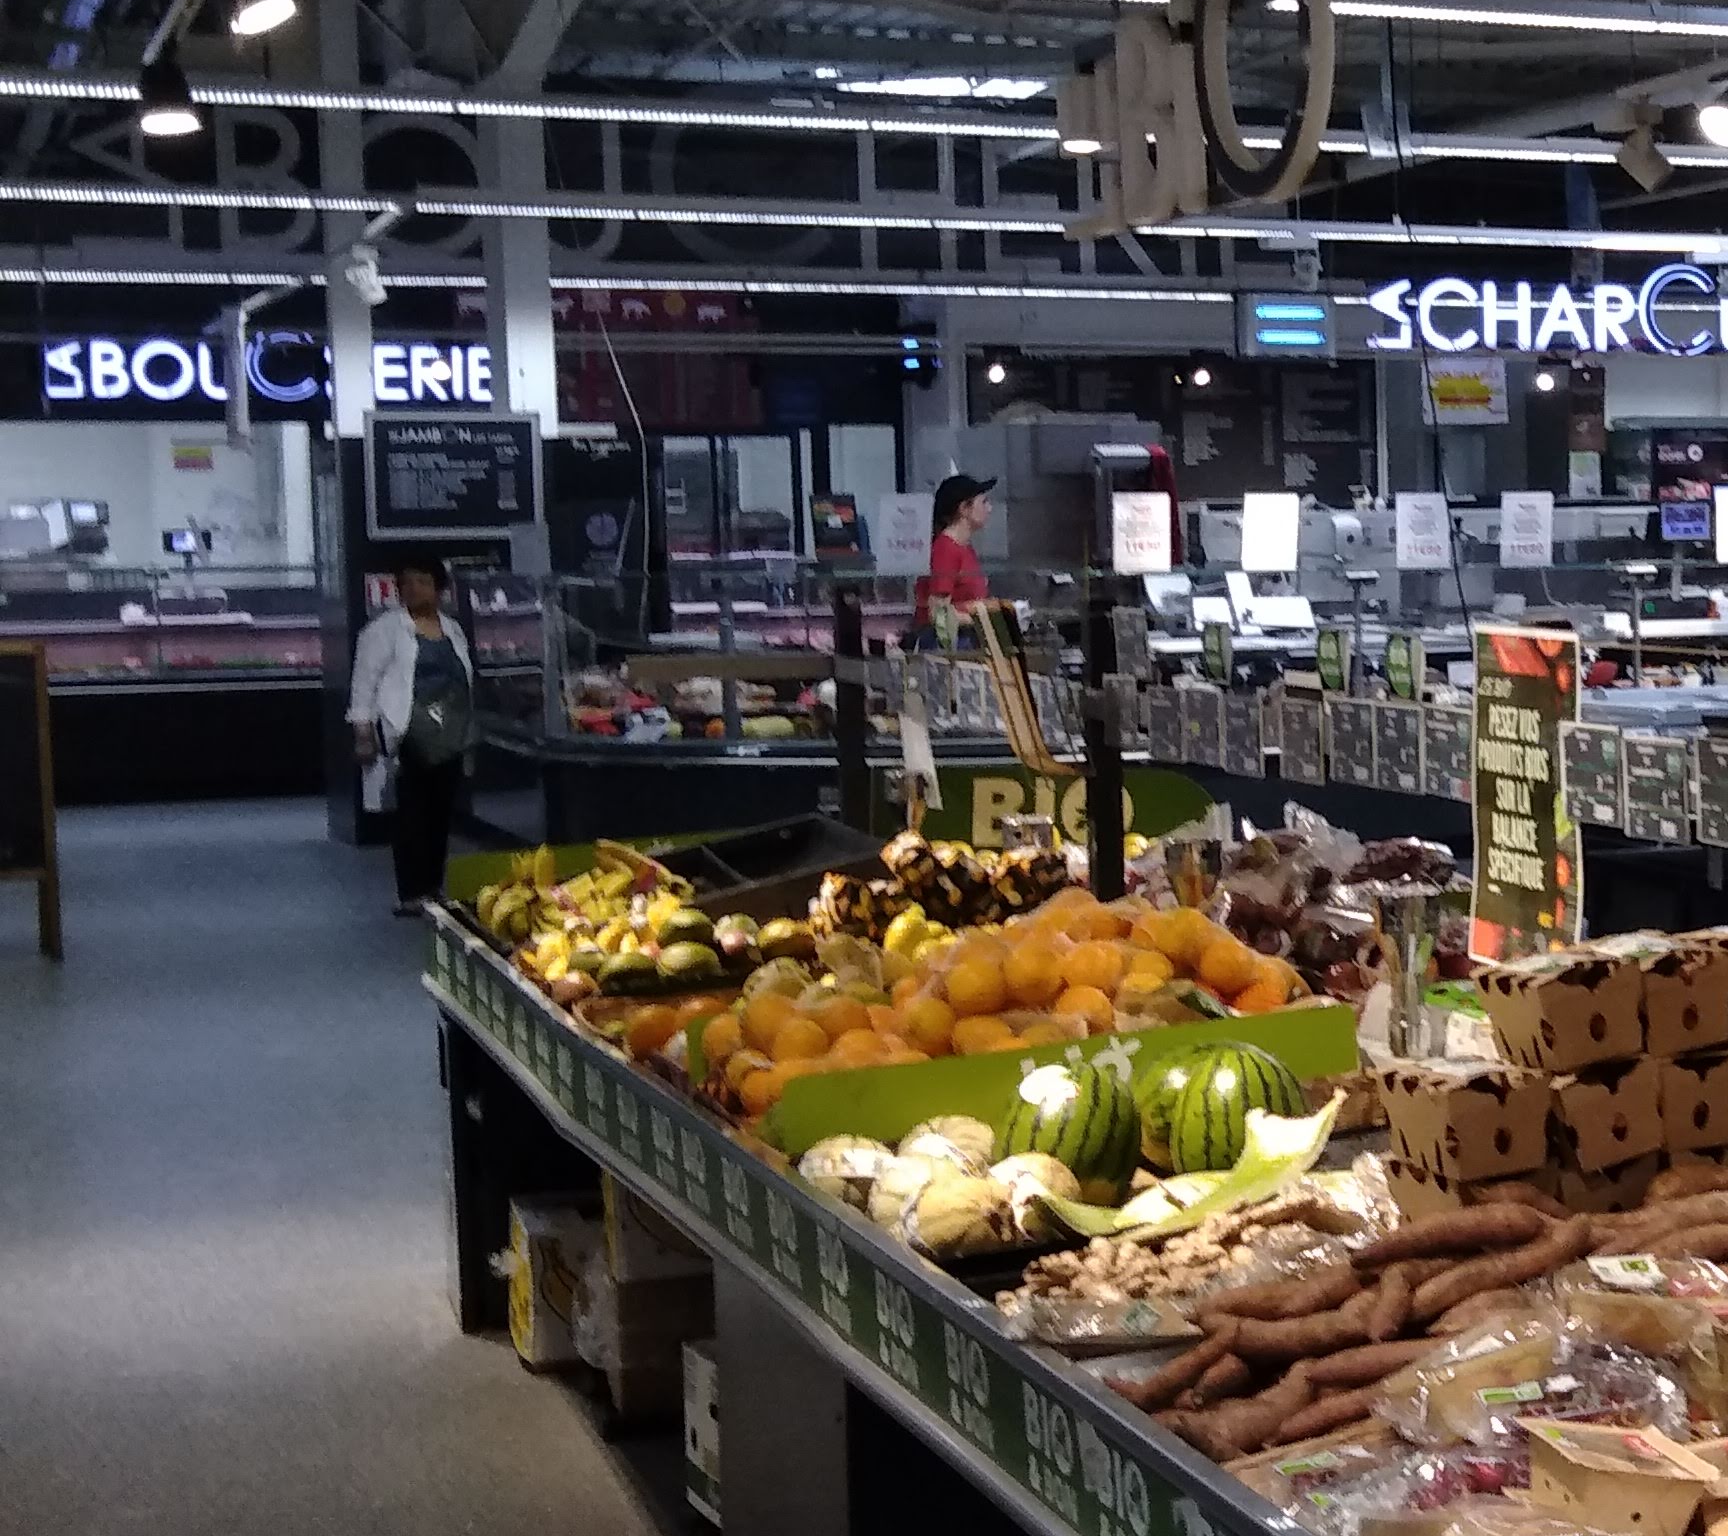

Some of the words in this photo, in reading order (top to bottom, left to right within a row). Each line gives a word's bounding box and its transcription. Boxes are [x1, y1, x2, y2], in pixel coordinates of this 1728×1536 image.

[1365, 279, 1413, 351] LA
[44, 340, 84, 400] LA
[88, 330, 494, 402] BOUCERIE
[1022, 1380, 1073, 1477] BIO
